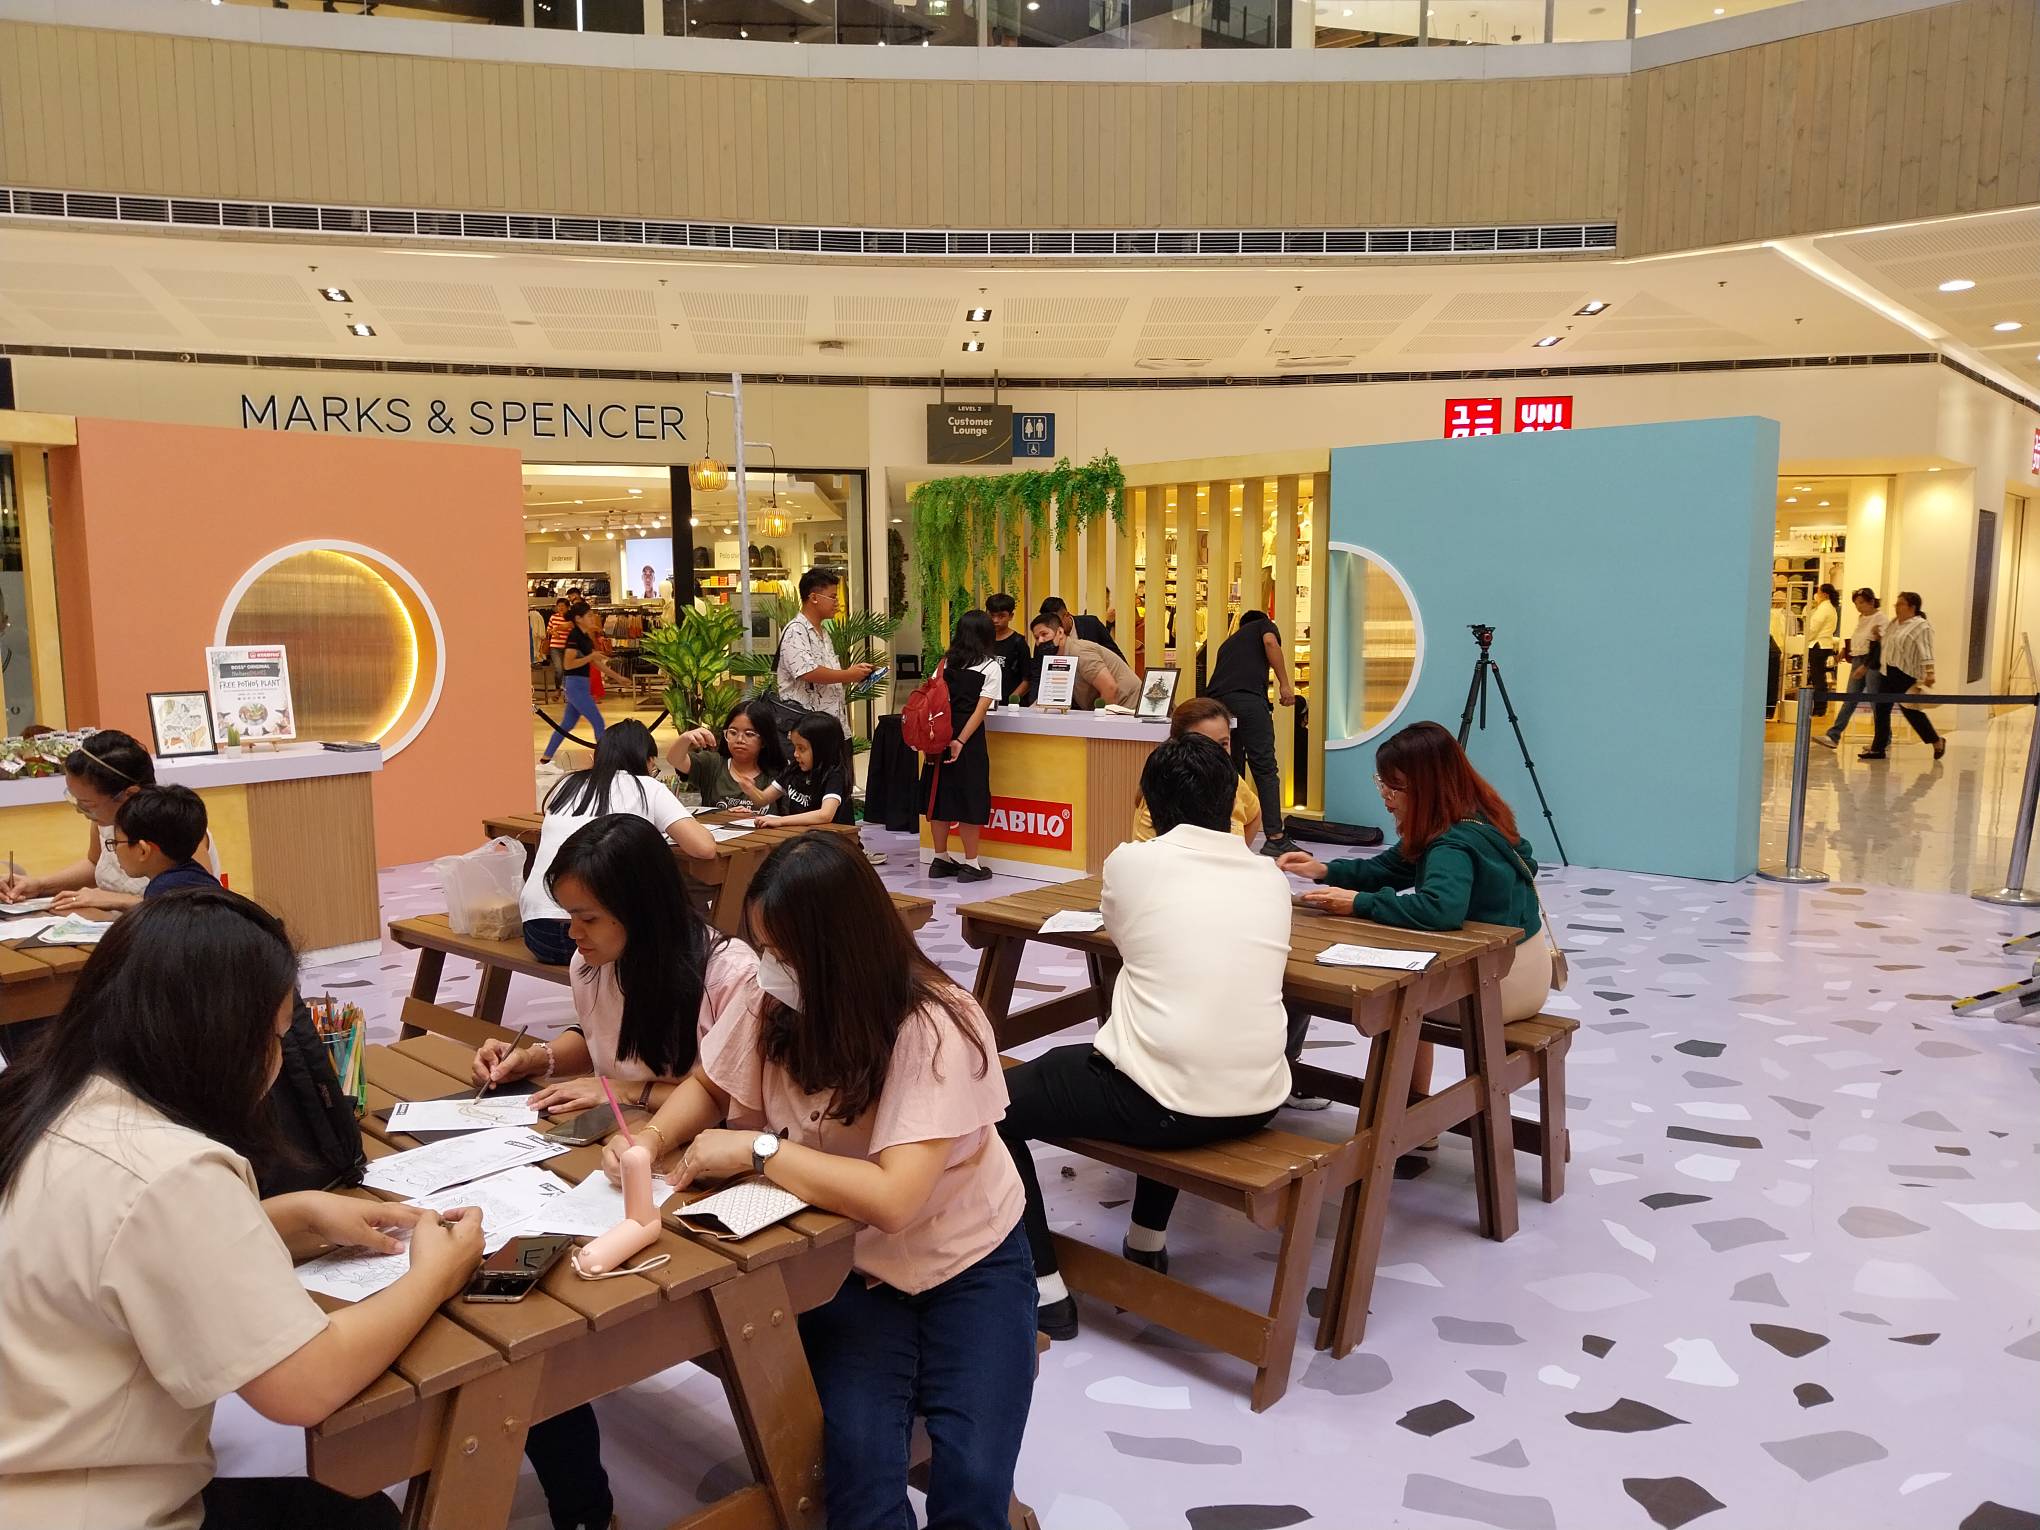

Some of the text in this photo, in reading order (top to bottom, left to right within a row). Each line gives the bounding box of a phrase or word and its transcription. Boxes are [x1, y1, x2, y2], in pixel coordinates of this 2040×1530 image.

[240, 393, 688, 441] MARKS & SPENCER
[948, 417, 993, 426] Customer
[1520, 403, 1563, 424] UNI
[953, 426, 988, 437] Lounge
